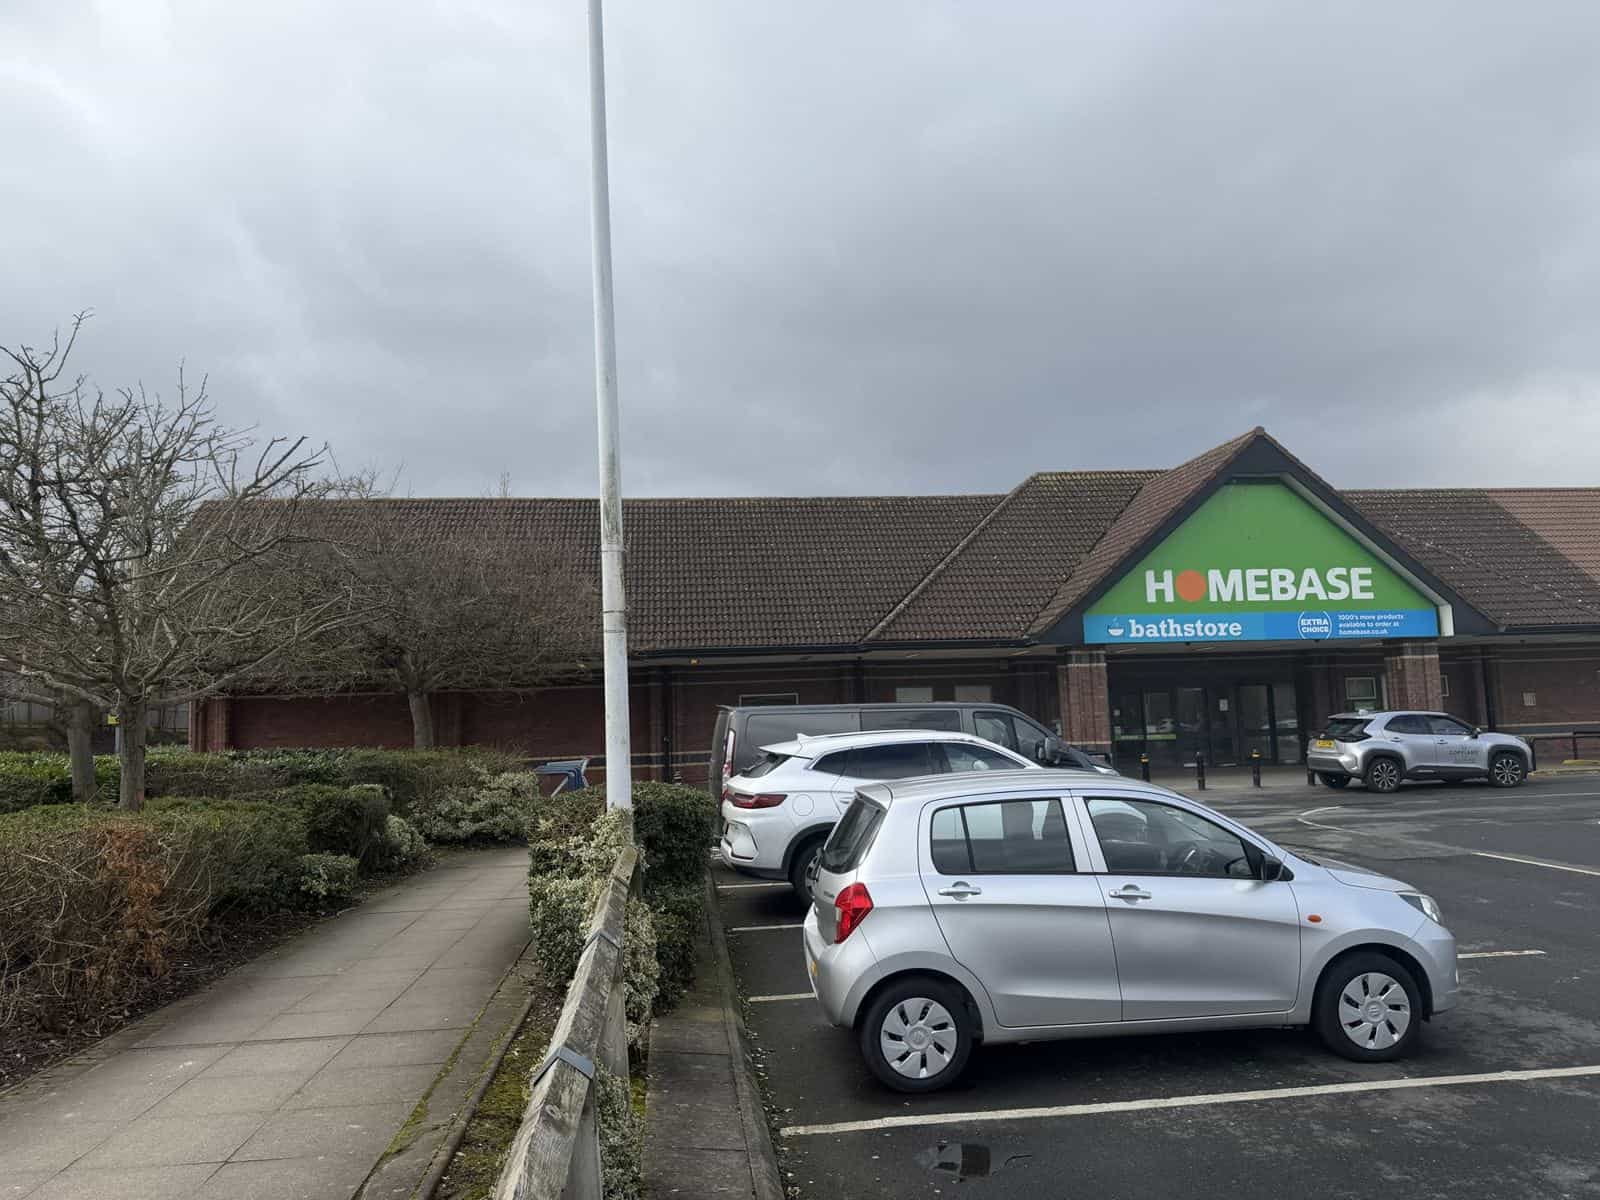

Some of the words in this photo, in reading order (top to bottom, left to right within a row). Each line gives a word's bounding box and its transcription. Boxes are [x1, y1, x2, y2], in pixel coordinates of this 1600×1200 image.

[1145, 567, 1374, 603] HOMEBASE
[1129, 618, 1242, 638] bathstore
[1301, 618, 1329, 626] EXTRA
